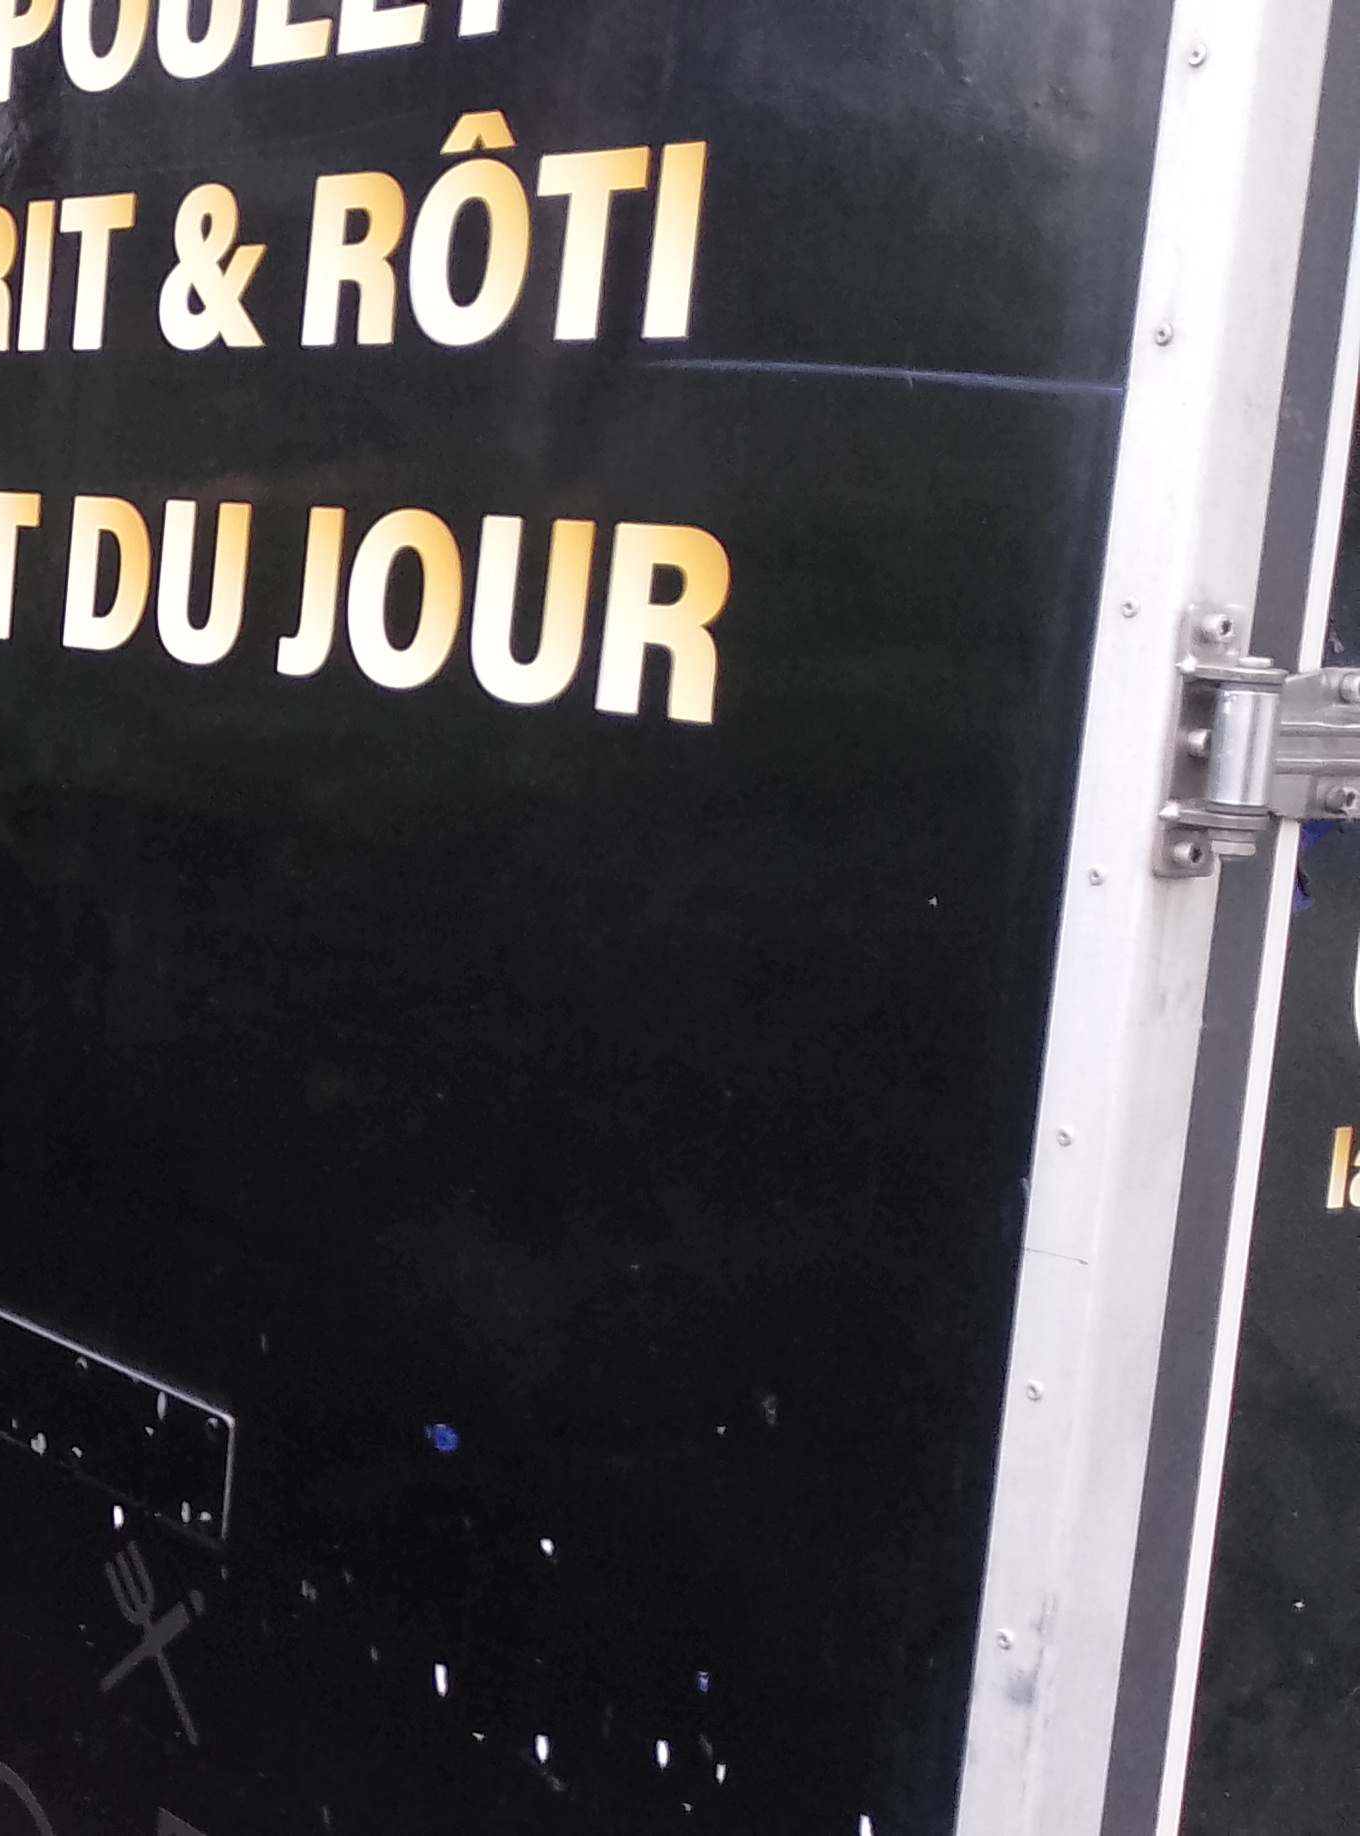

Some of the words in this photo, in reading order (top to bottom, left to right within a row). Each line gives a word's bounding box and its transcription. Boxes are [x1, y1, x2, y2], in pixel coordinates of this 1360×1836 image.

[157, 182, 267, 351] &
[300, 109, 708, 349] RÔTI
[61, 494, 253, 666] DU
[276, 505, 732, 725] JOUR
